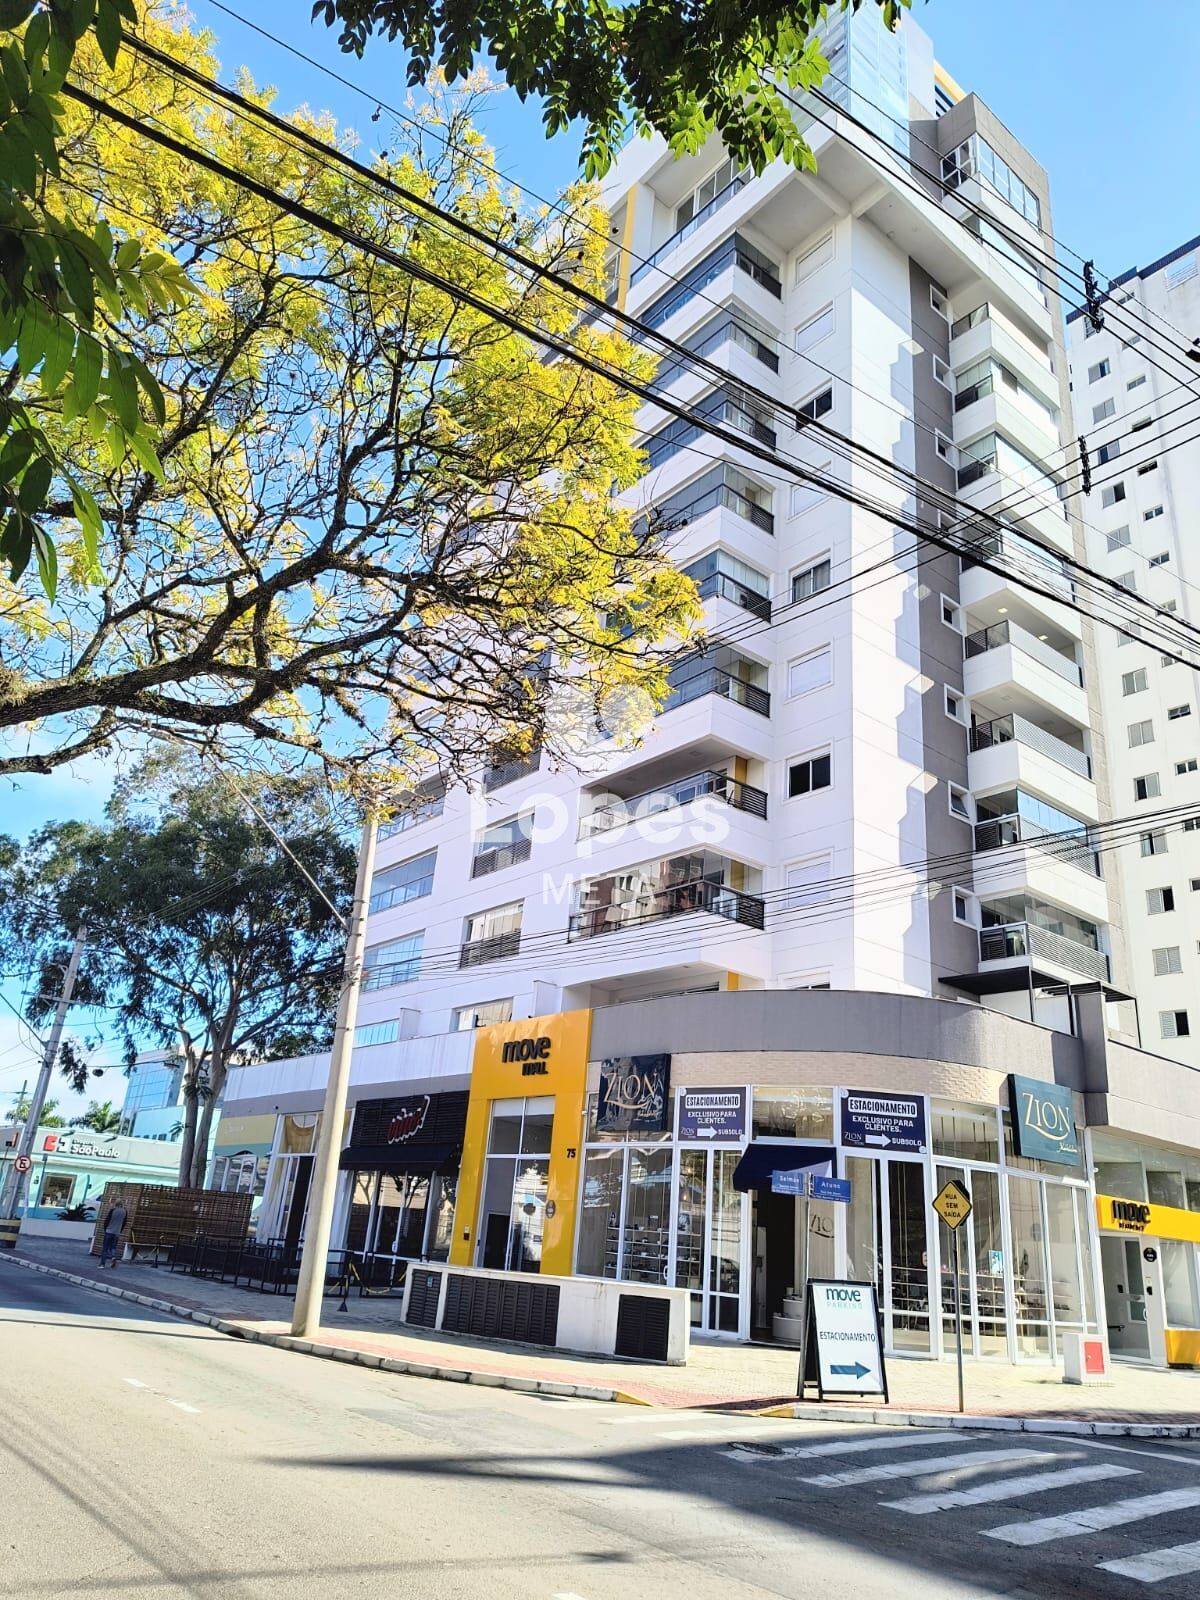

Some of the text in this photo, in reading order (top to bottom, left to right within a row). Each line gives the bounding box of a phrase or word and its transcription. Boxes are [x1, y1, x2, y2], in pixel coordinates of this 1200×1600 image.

[502, 1037, 551, 1063] move
[603, 1072, 657, 1110] ZION
[686, 1096, 739, 1106] ESTACIONAMENTO
[849, 1099, 916, 1115] ESTACIONAMENTO
[852, 1115, 914, 1127] EXCLUSIVO PARA
[1022, 1092, 1071, 1140] ZION
[864, 1123, 903, 1133] CLIENTES.
[891, 1138, 922, 1146] SUBSOLO
[566, 1148, 576, 1158] 75
[1112, 1200, 1151, 1224] move
[826, 1288, 861, 1302] move
[819, 1331, 876, 1342] ESTACIONAMENTO
